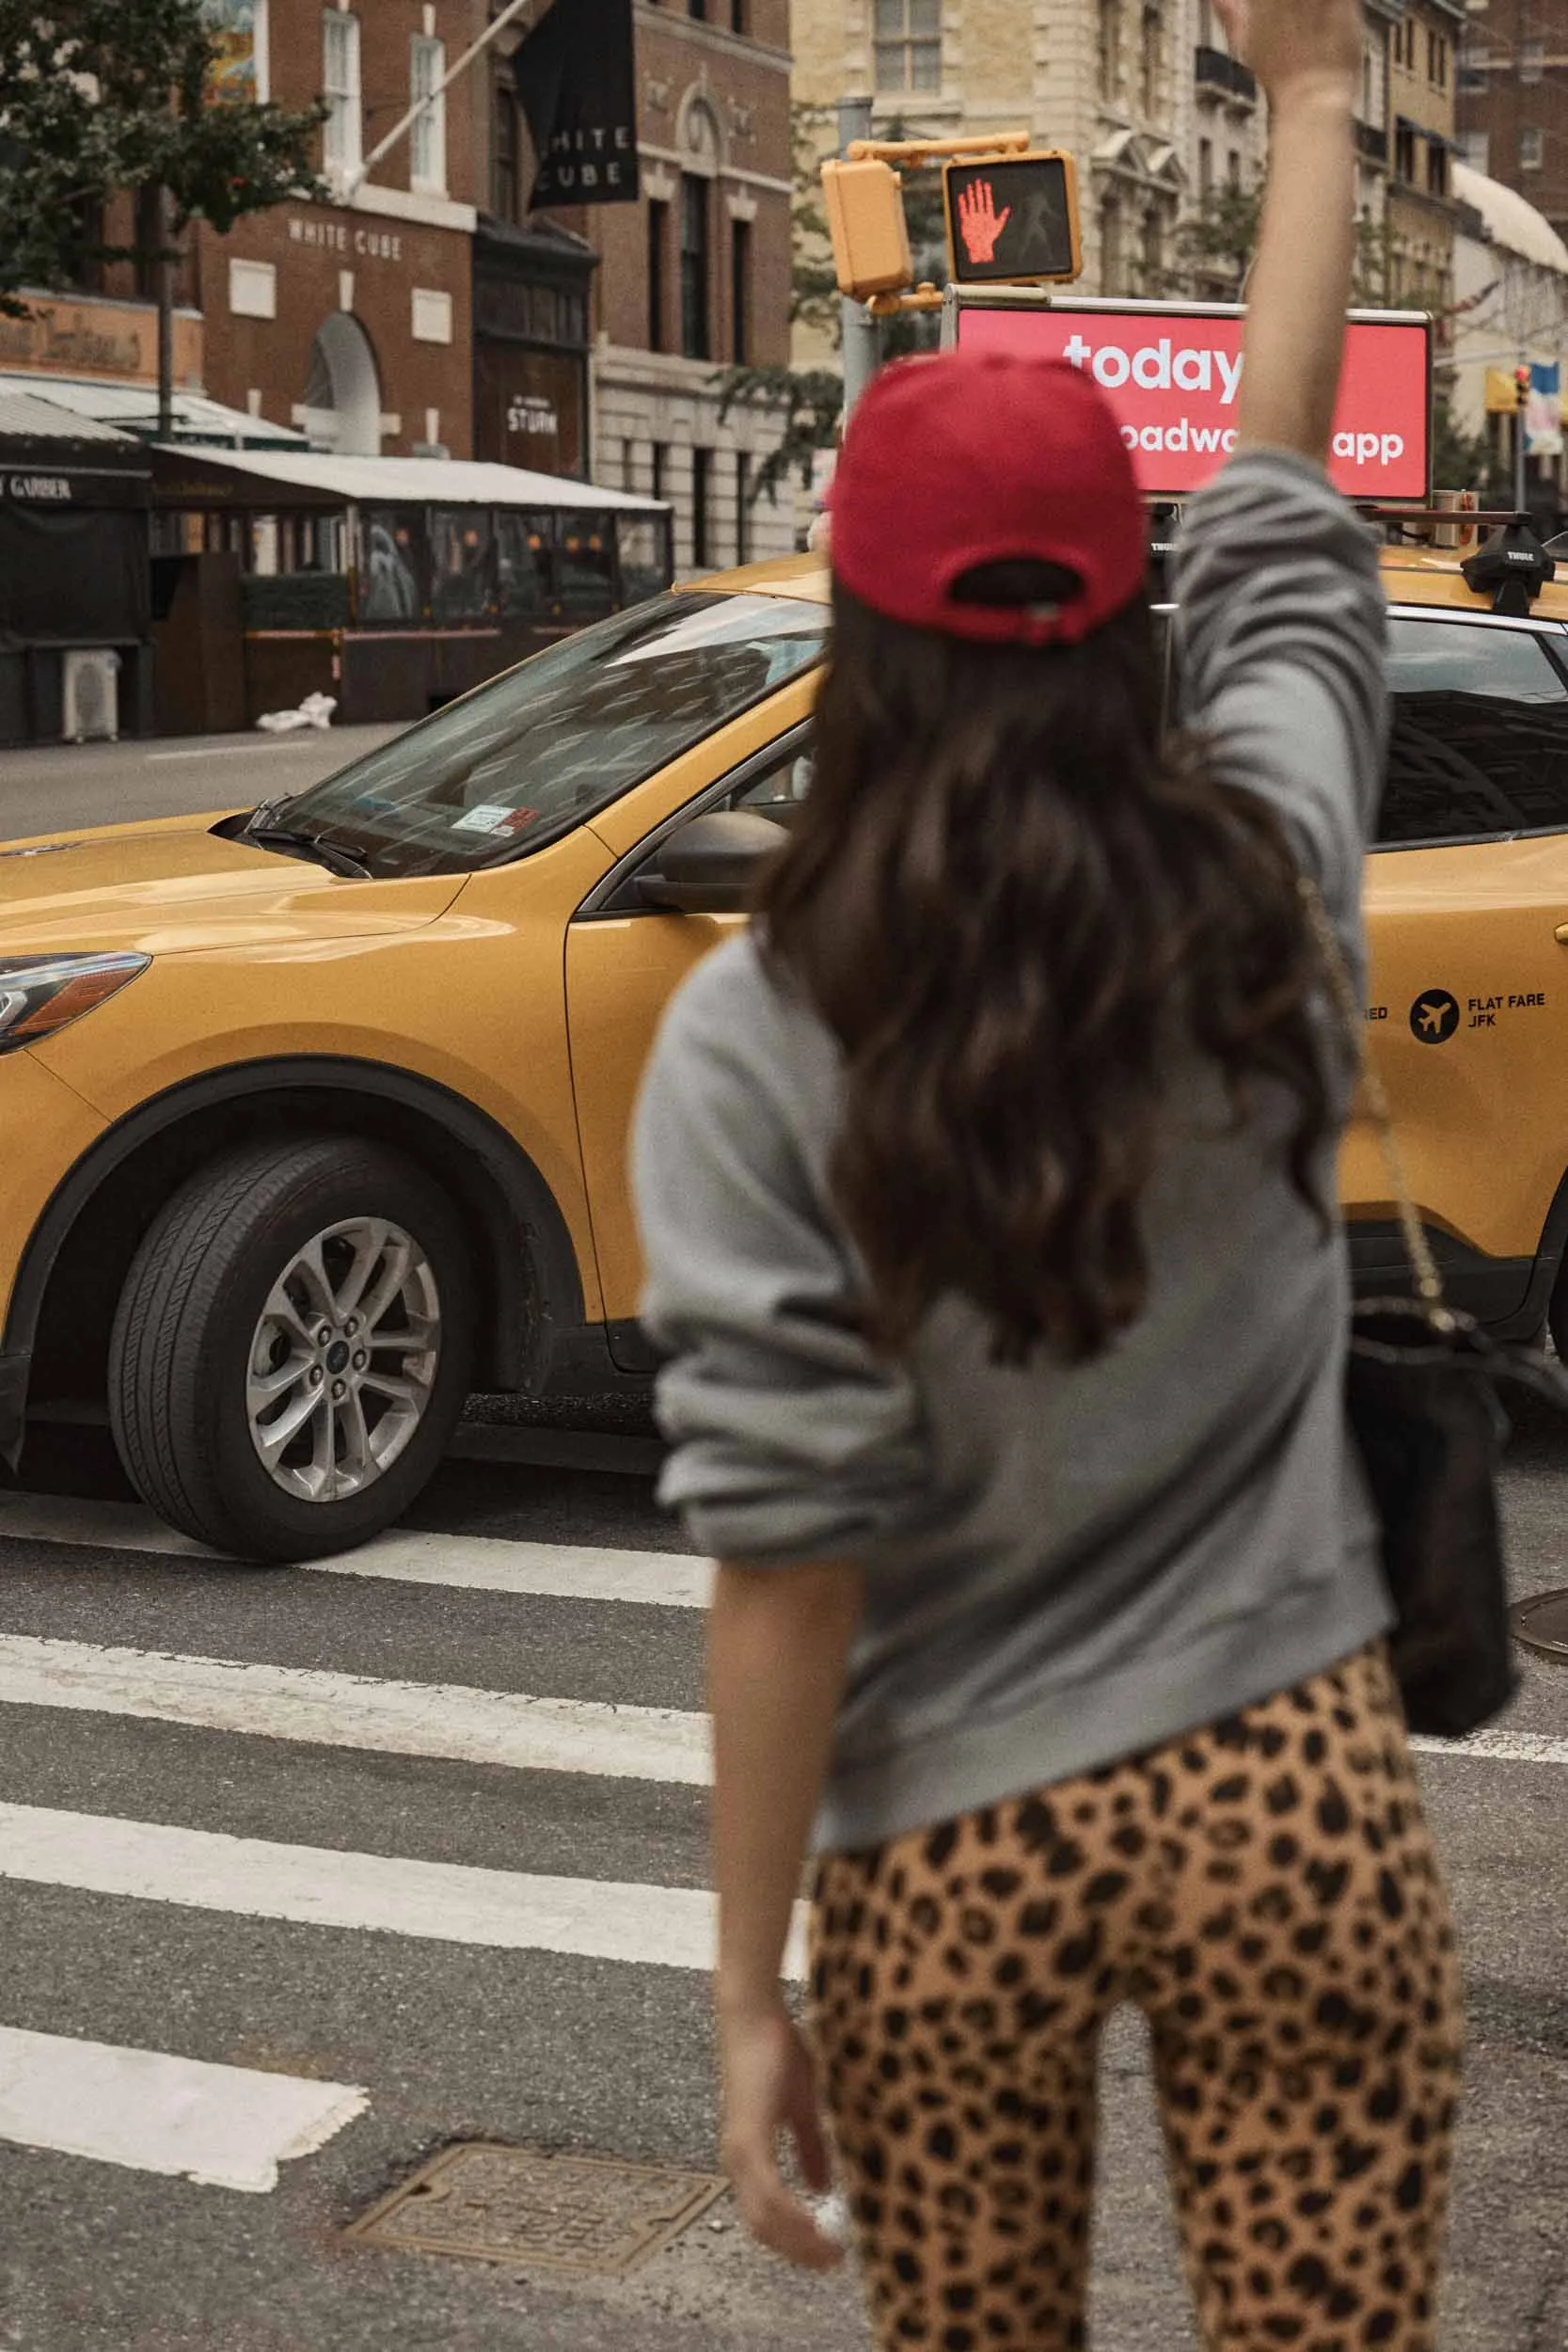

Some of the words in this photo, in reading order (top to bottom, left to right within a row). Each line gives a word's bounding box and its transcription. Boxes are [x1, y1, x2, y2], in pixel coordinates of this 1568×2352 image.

[288, 218, 346, 251] WHITE
[355, 230, 402, 261] CUBE
[1332, 432, 1404, 465] app
[1507, 551, 1534, 562] THULE
[1467, 997, 1503, 1011] FLAT
[1508, 993, 1544, 1008] FARE
[1467, 1015, 1497, 1028] JFK
